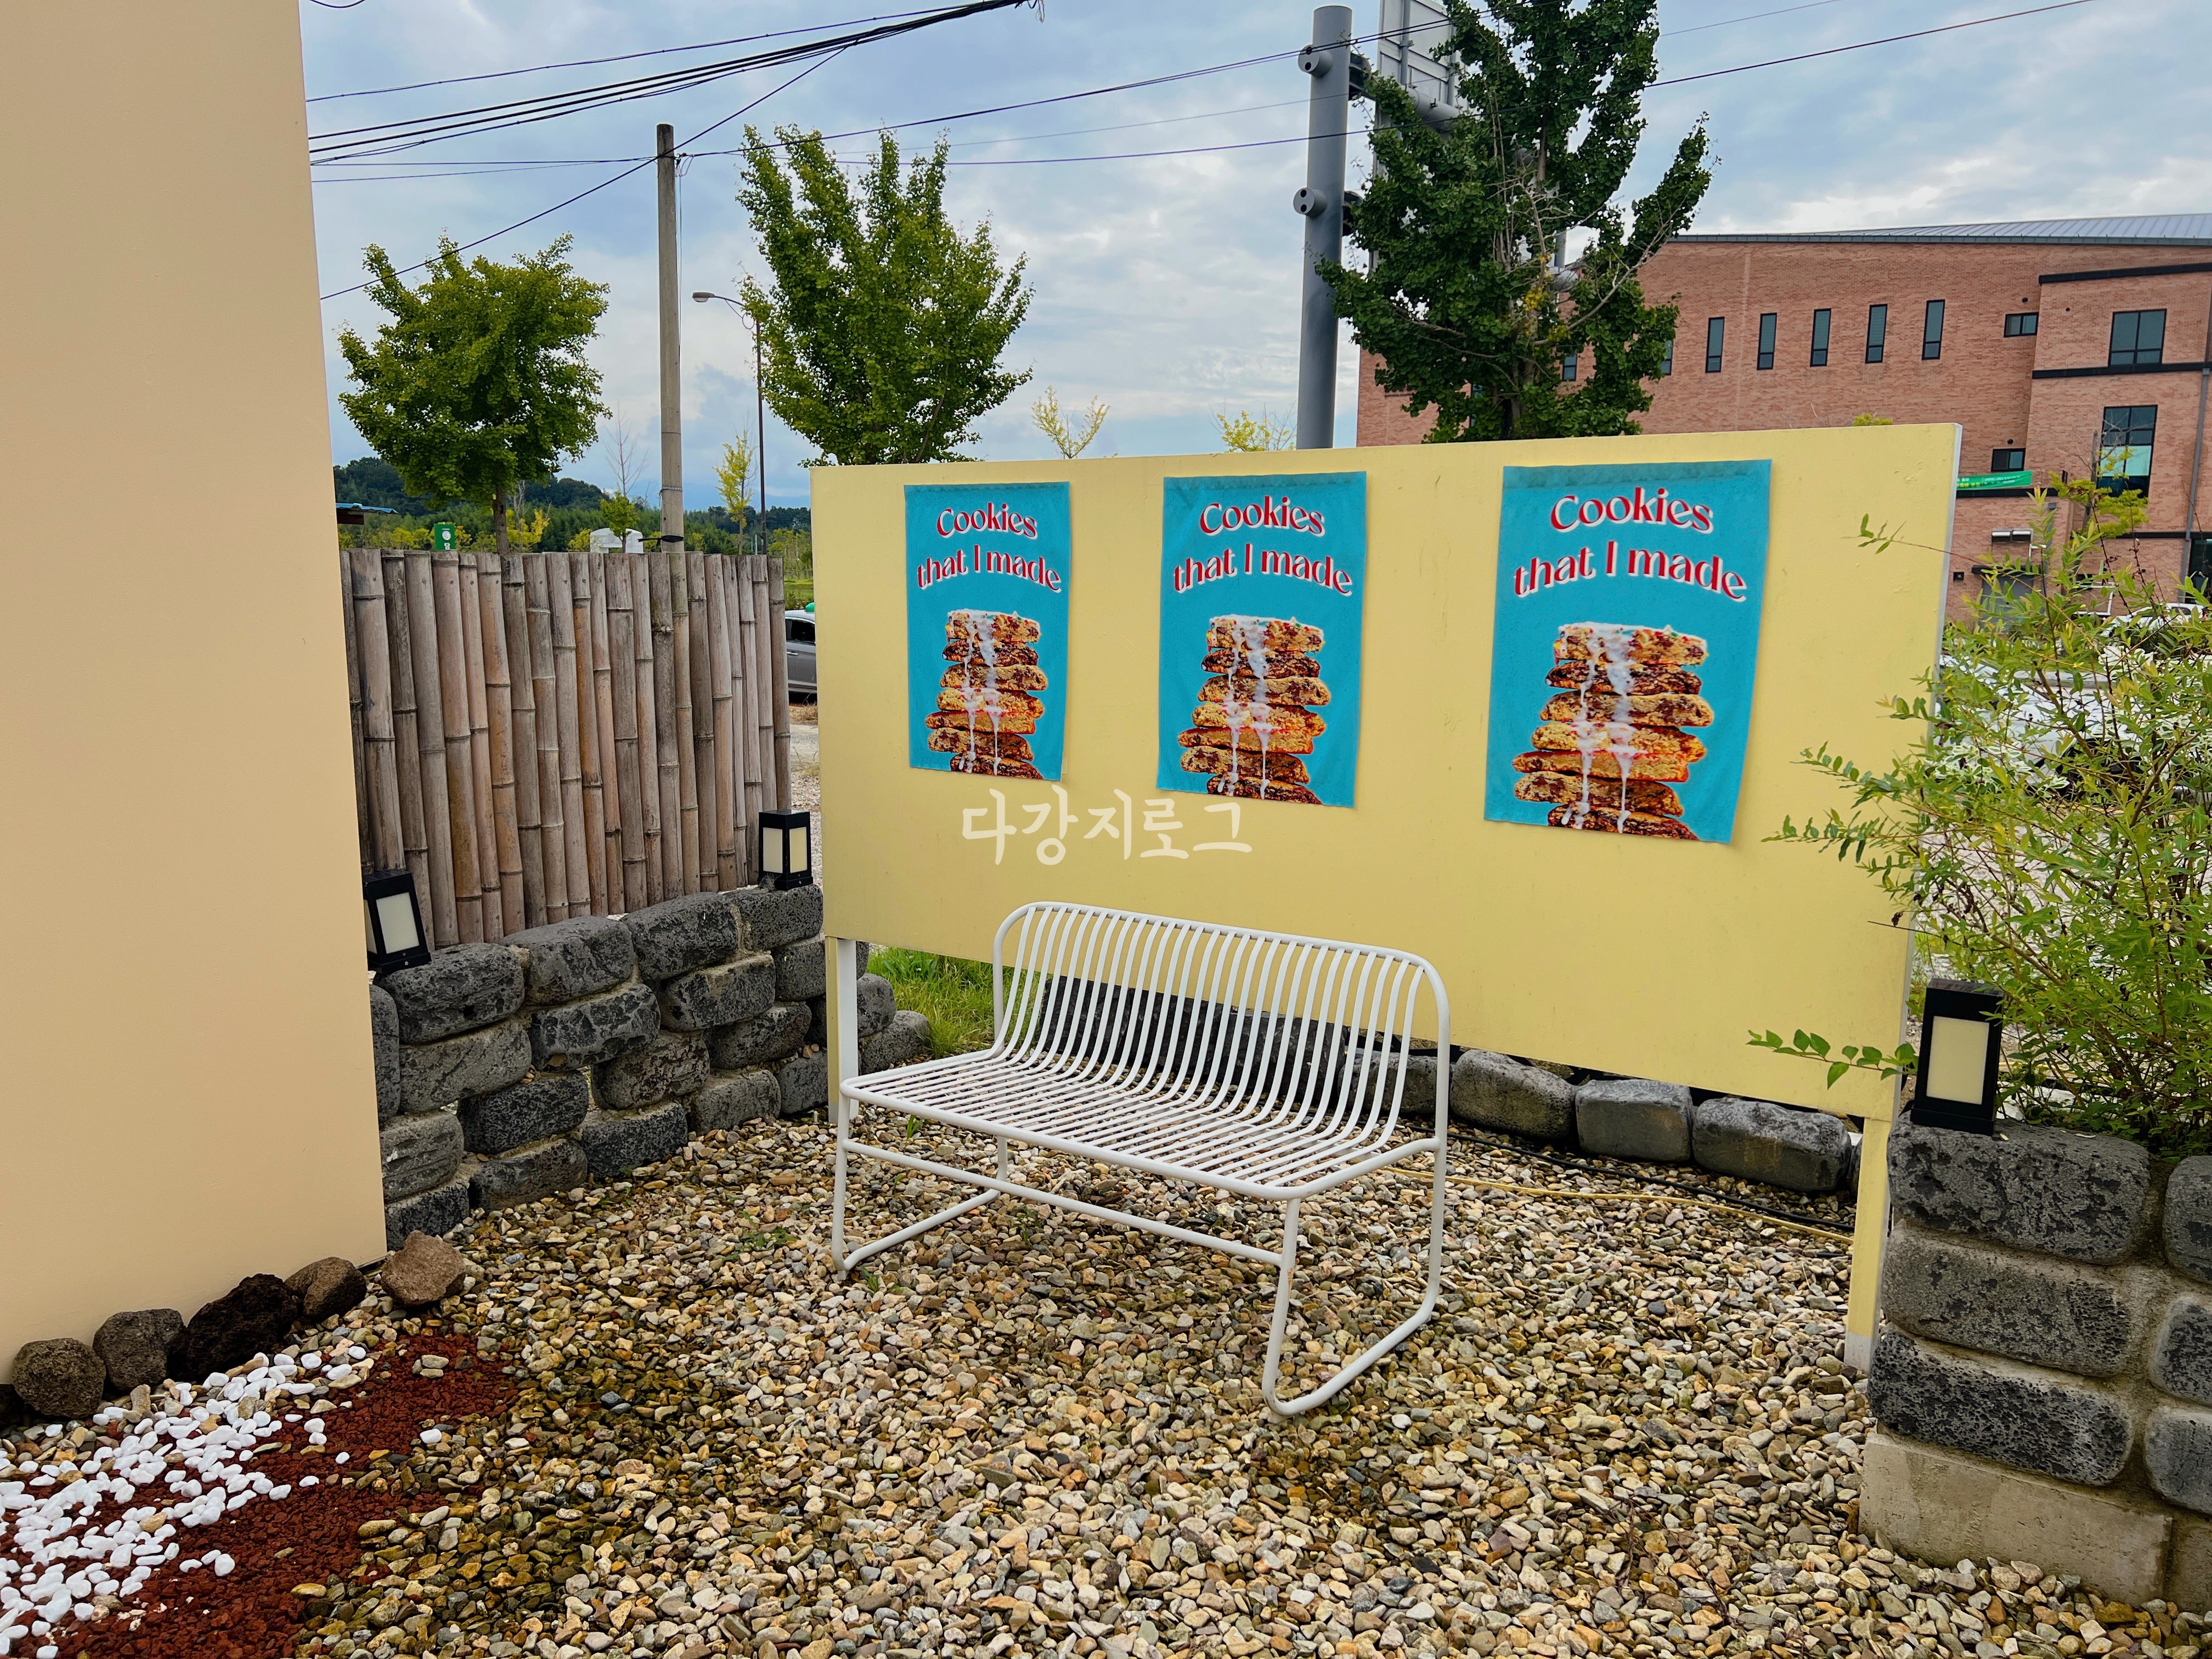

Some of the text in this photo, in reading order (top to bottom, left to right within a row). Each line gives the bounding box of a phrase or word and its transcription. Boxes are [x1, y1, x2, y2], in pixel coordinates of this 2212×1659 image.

[936, 502, 1038, 540] Cookies
[1200, 495, 1325, 537] Cookies
[1550, 487, 1714, 534] Cookies
[917, 544, 1062, 593] that I made
[1173, 543, 1353, 596] that I made
[1514, 540, 1747, 602] that I made
